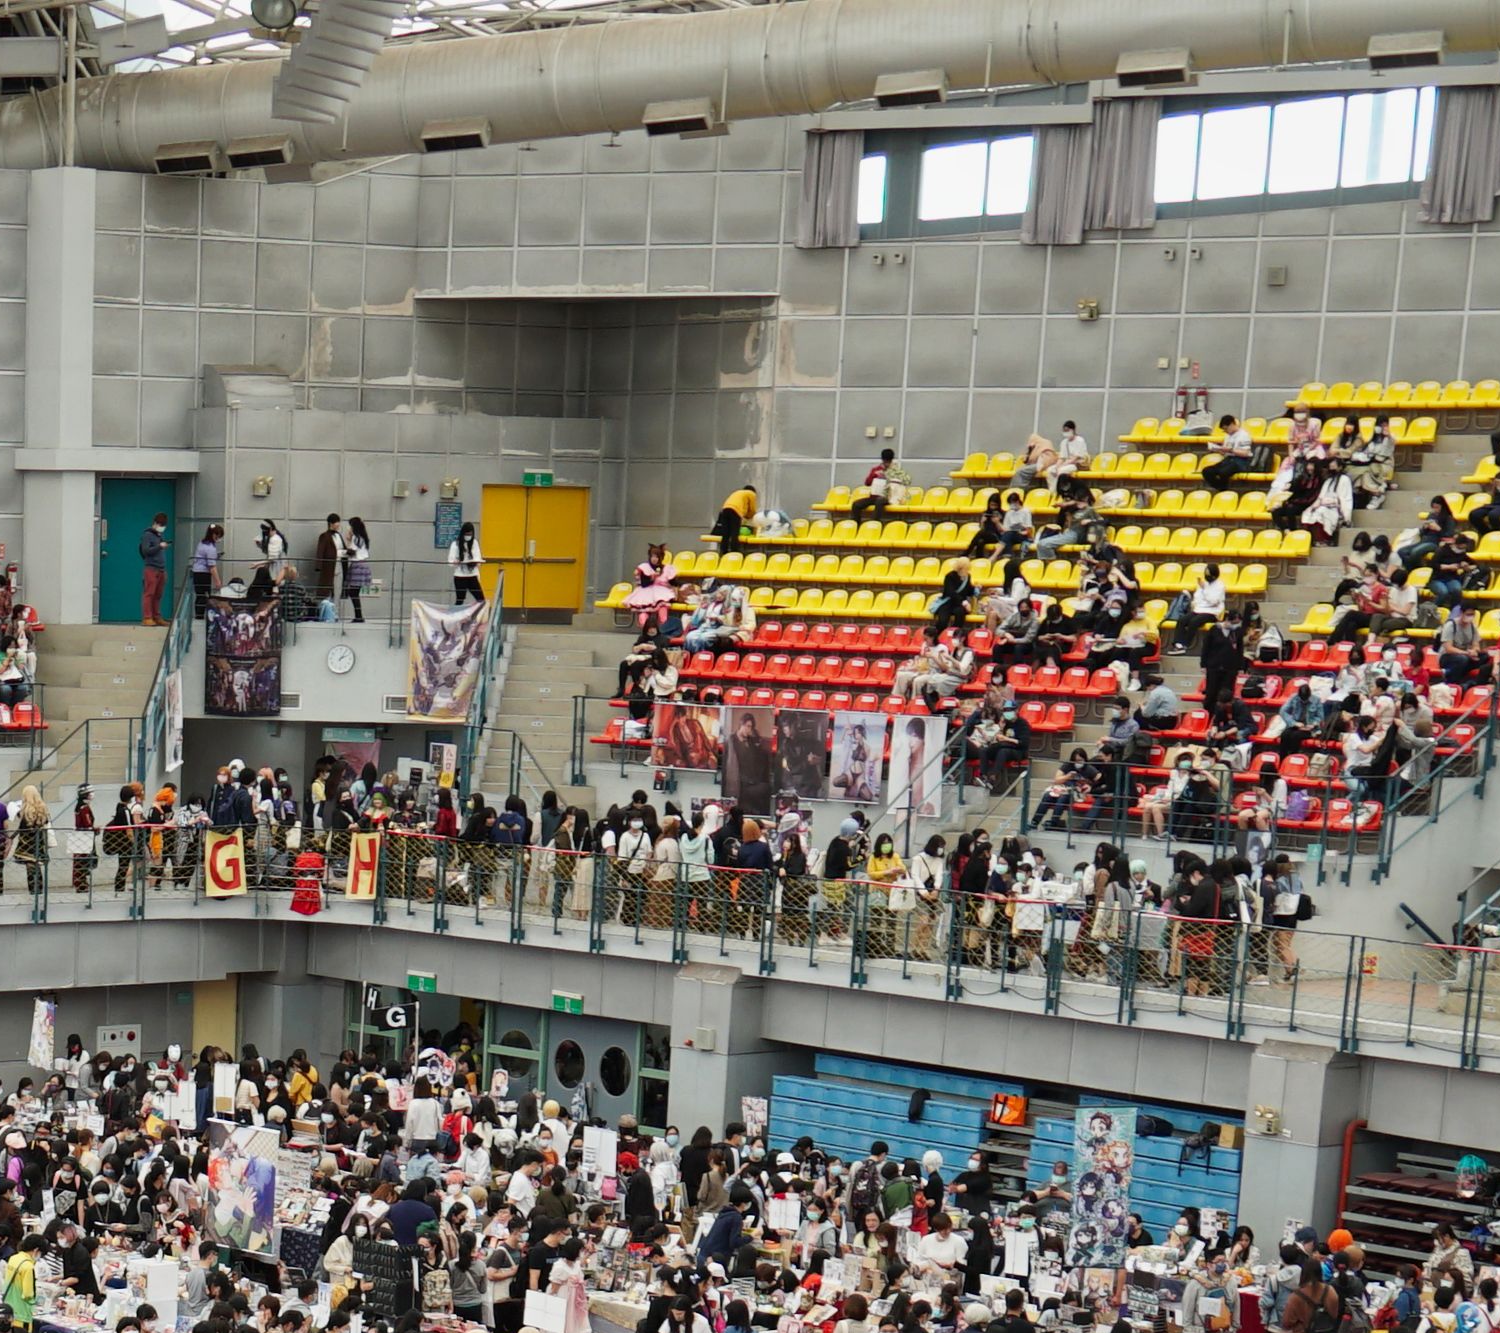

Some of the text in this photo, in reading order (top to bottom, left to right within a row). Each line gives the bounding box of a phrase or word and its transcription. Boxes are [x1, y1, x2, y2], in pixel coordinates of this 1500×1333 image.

[210, 834, 241, 890] G
[351, 836, 378, 894] H
[386, 1006, 406, 1028] G
